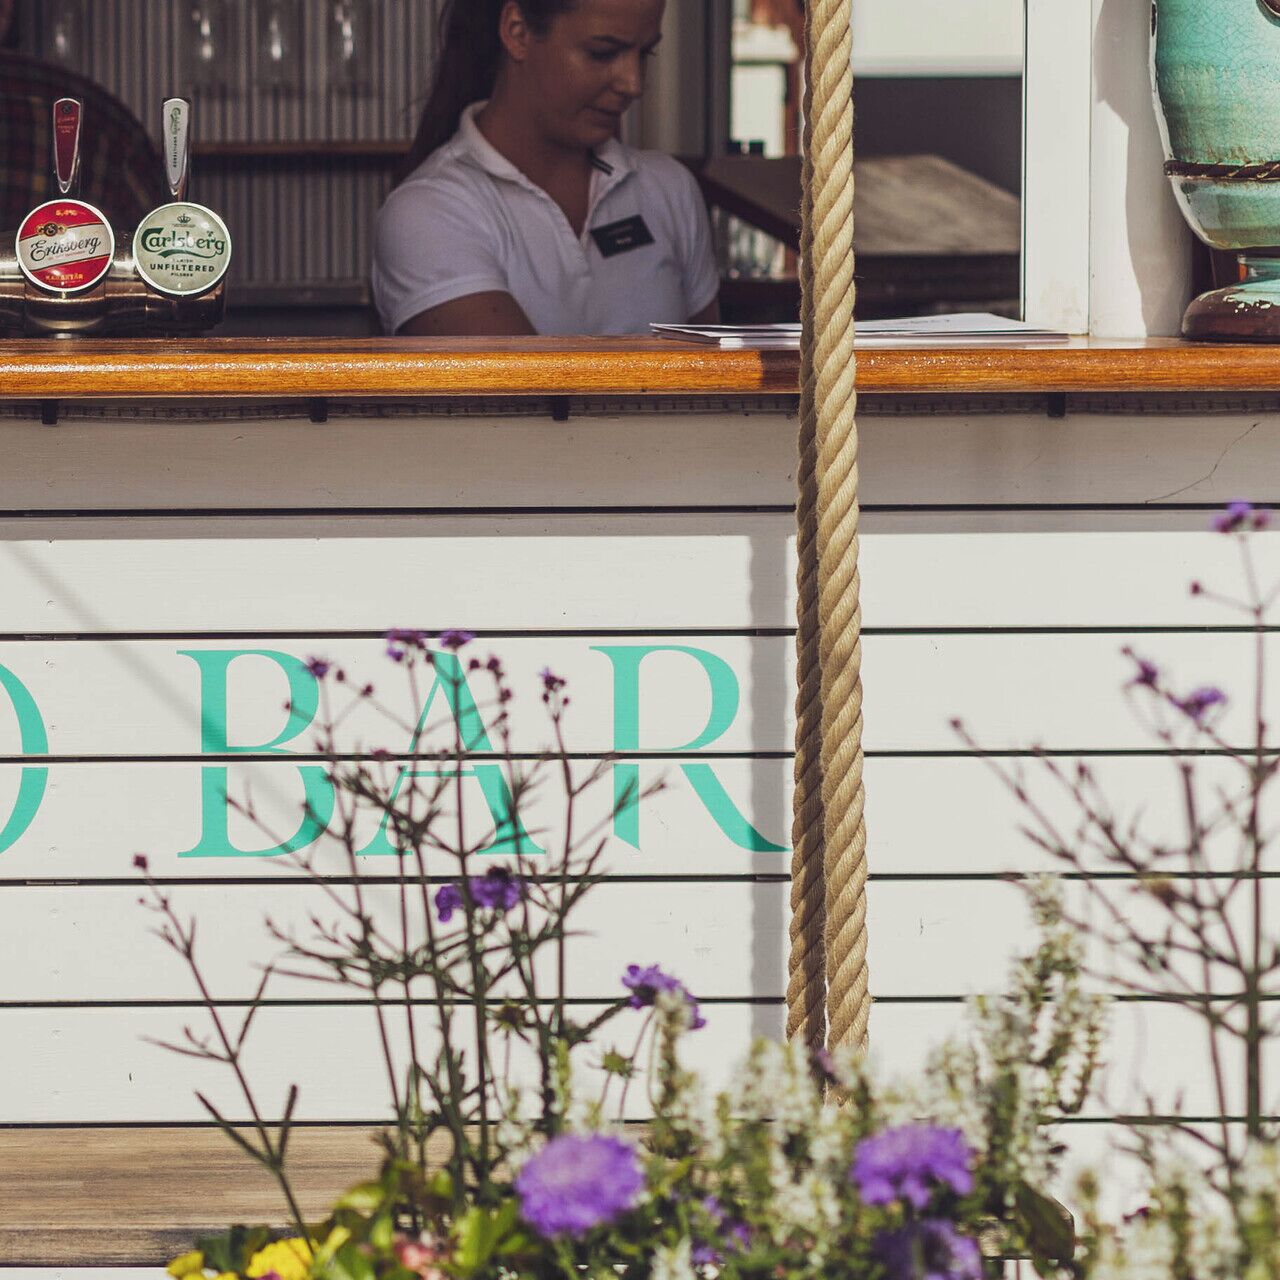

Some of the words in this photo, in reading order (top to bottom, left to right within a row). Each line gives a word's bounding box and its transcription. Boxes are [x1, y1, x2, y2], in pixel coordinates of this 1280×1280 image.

[141, 227, 225, 258] Carlsberg
[150, 263, 215, 273] UNFILTERED
[177, 644, 793, 858] BAR
